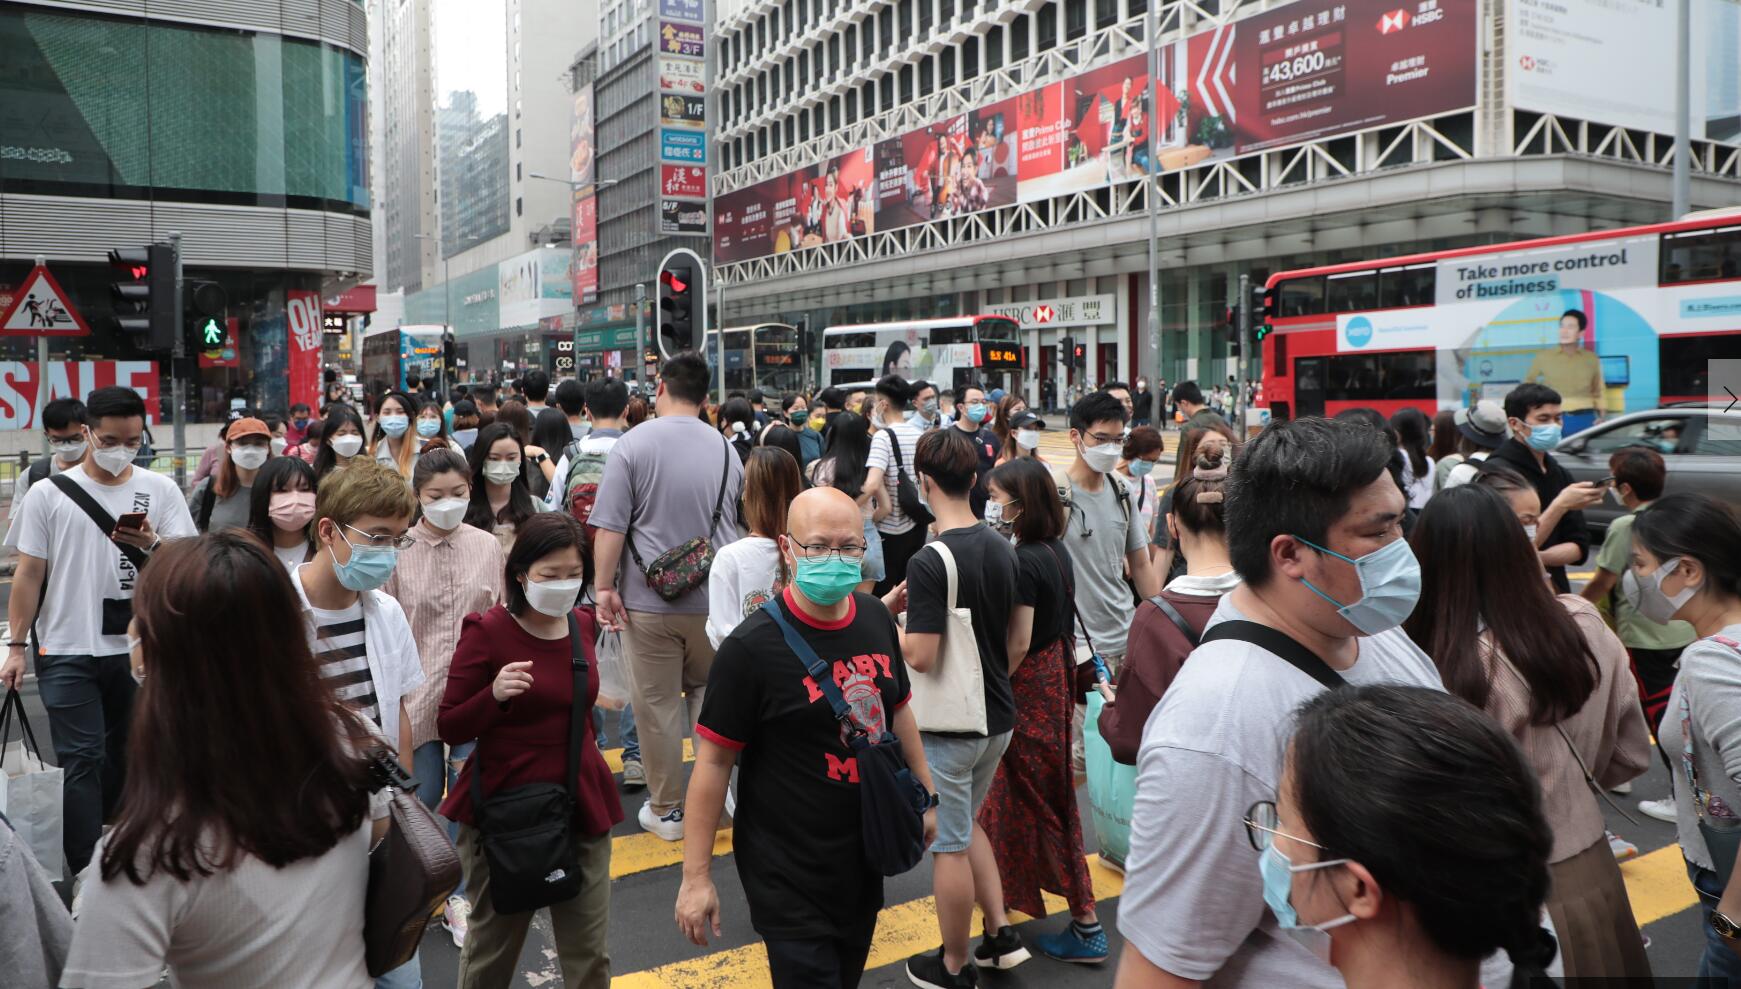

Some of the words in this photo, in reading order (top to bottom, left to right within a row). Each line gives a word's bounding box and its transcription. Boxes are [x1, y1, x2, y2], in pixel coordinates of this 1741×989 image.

[1412, 9, 1443, 27] HSBC
[683, 43, 700, 54] 3/F
[1270, 52, 1324, 81] 43,600
[1386, 67, 1429, 86] Premier
[688, 103, 703, 115] 1/F
[1457, 265, 1498, 280] Take
[1502, 261, 1549, 277] more
[1553, 249, 1628, 271] control
[1456, 284, 1474, 299] of
[1477, 279, 1556, 298] business
[288, 295, 321, 335] OH
